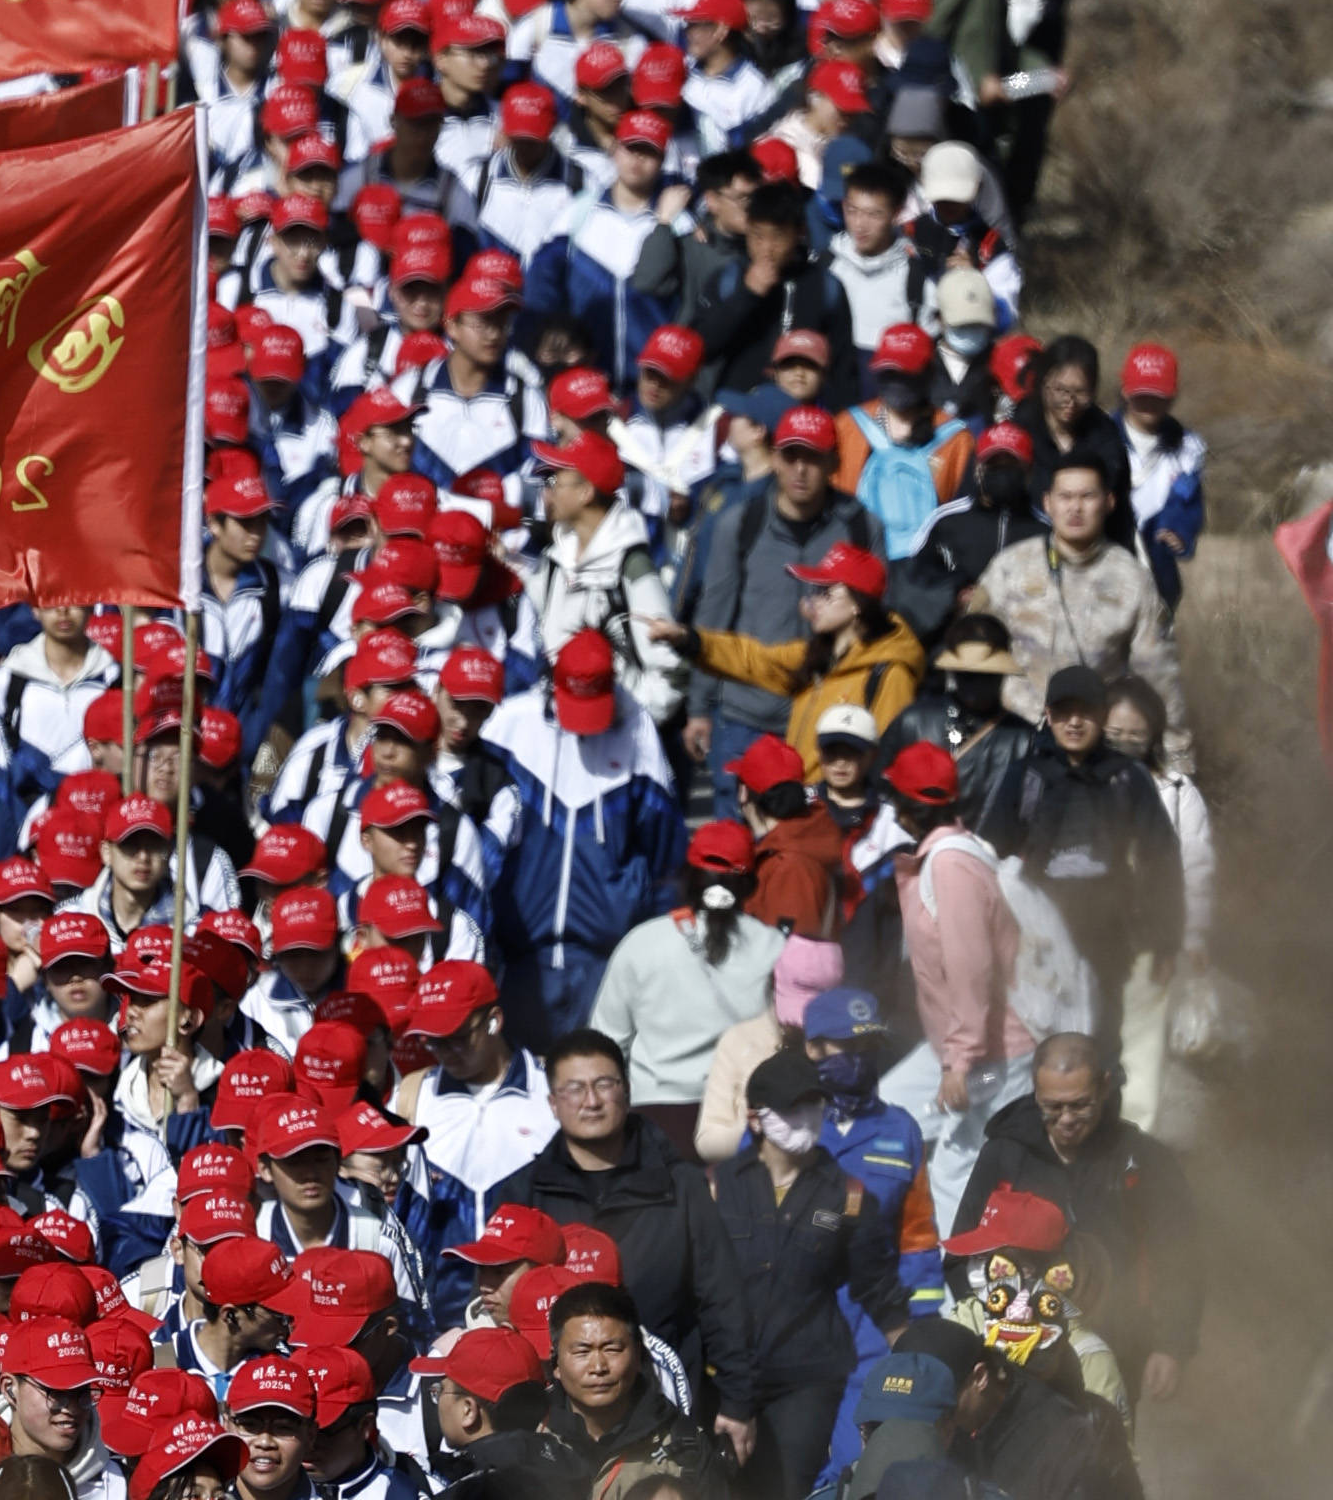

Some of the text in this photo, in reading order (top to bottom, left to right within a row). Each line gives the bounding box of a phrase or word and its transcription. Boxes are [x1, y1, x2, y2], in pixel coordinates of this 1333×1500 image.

[193, 1153, 234, 1170] 固原二中
[35, 1217, 76, 1235] 固原二中
[254, 1366, 298, 1384] 固原二中
[260, 1380, 293, 1392] 2025级
